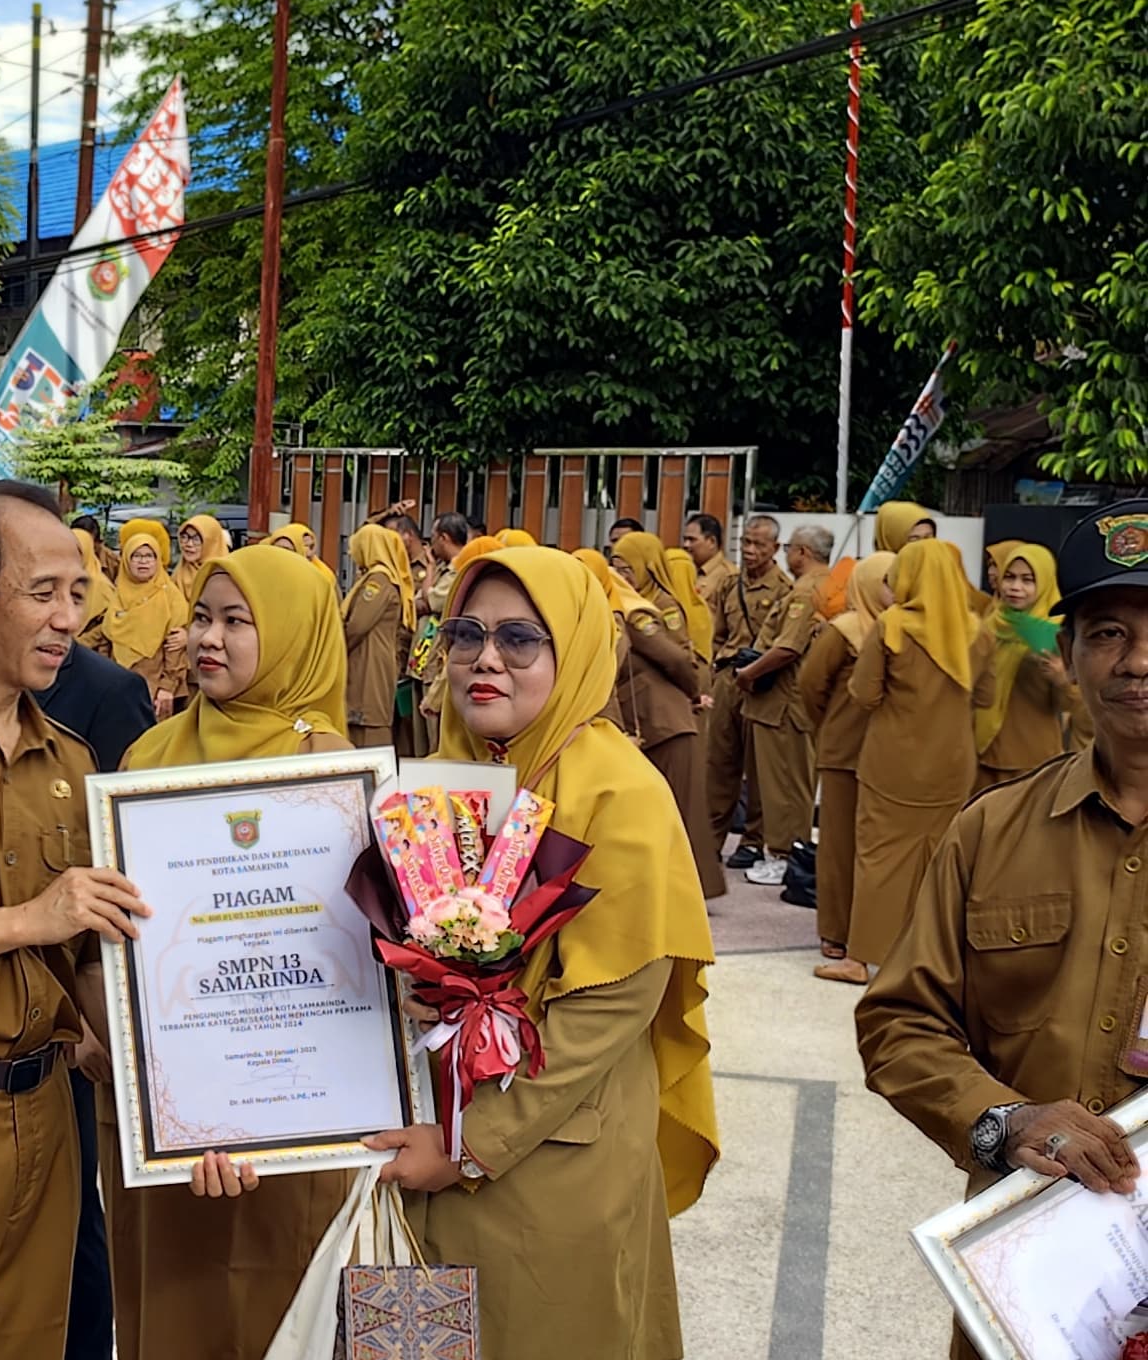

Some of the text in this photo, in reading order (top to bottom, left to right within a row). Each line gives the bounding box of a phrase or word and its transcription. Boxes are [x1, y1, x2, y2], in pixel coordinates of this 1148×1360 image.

[168, 846, 331, 869] DINAS PENDIDIKAN DAN KEBUDAYAAN
[212, 861, 289, 876] KOTA SAMARINDA
[212, 886, 295, 909] PIAGAM
[197, 926, 318, 944] Piagam penghargaan ini diberikan
[218, 953, 301, 976] SMPN 13
[199, 968, 324, 994] SAMARINDA
[159, 1004, 372, 1032] TERBANYAK KATEGORI SEKOLAH MENENGAH PERTAMA
[183, 999, 346, 1021] PENGUNJUNG MUSEUM KOTA SAMARINDA
[230, 1025, 252, 1033] PADA
[254, 1022, 282, 1031] TAHUN
